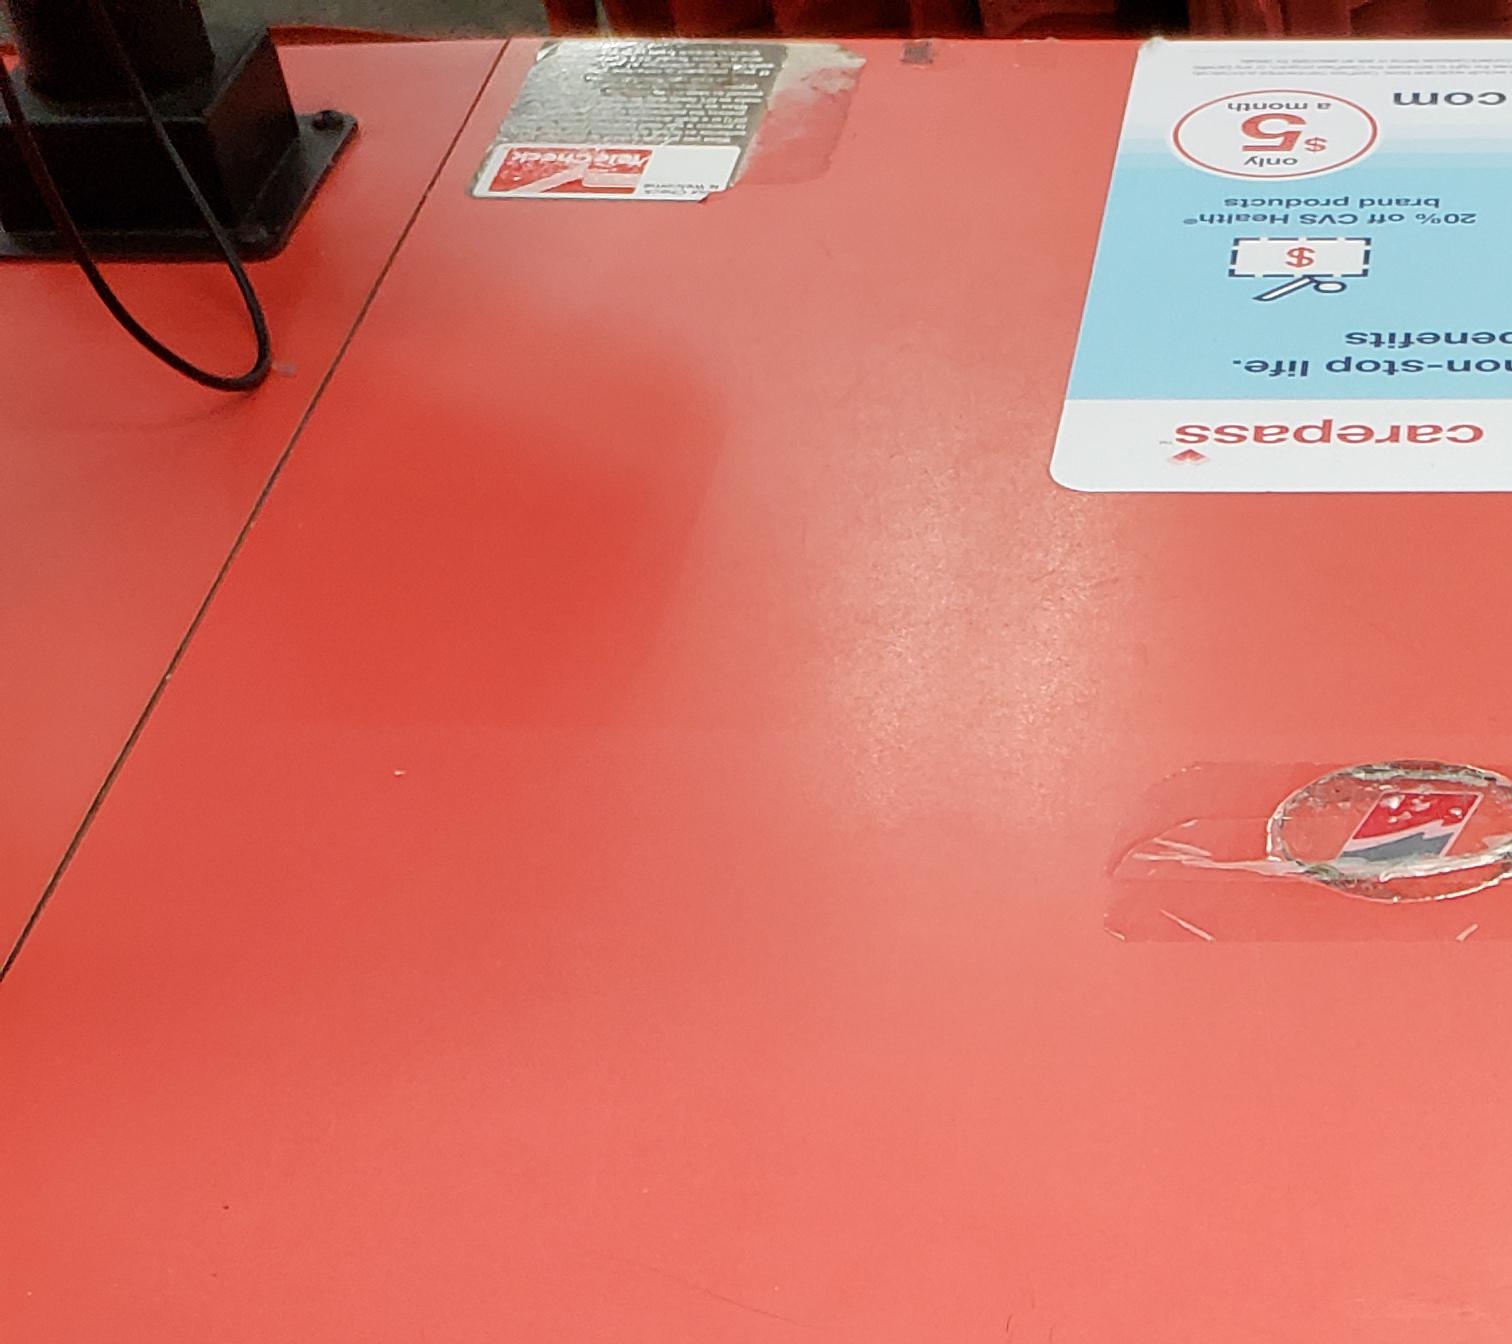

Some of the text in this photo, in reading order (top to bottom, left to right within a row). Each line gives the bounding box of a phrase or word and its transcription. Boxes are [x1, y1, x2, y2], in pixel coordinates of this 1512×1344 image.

[1227, 101, 1332, 113] a month
[1244, 156, 1298, 168] only
[1223, 196, 1440, 209] brand products
[1300, 213, 1358, 224] CVS
[1368, 213, 1405, 224] off
[1415, 213, 1477, 224] 20%
[1232, 358, 1310, 378] life.
[1174, 419, 1485, 449] carepass
